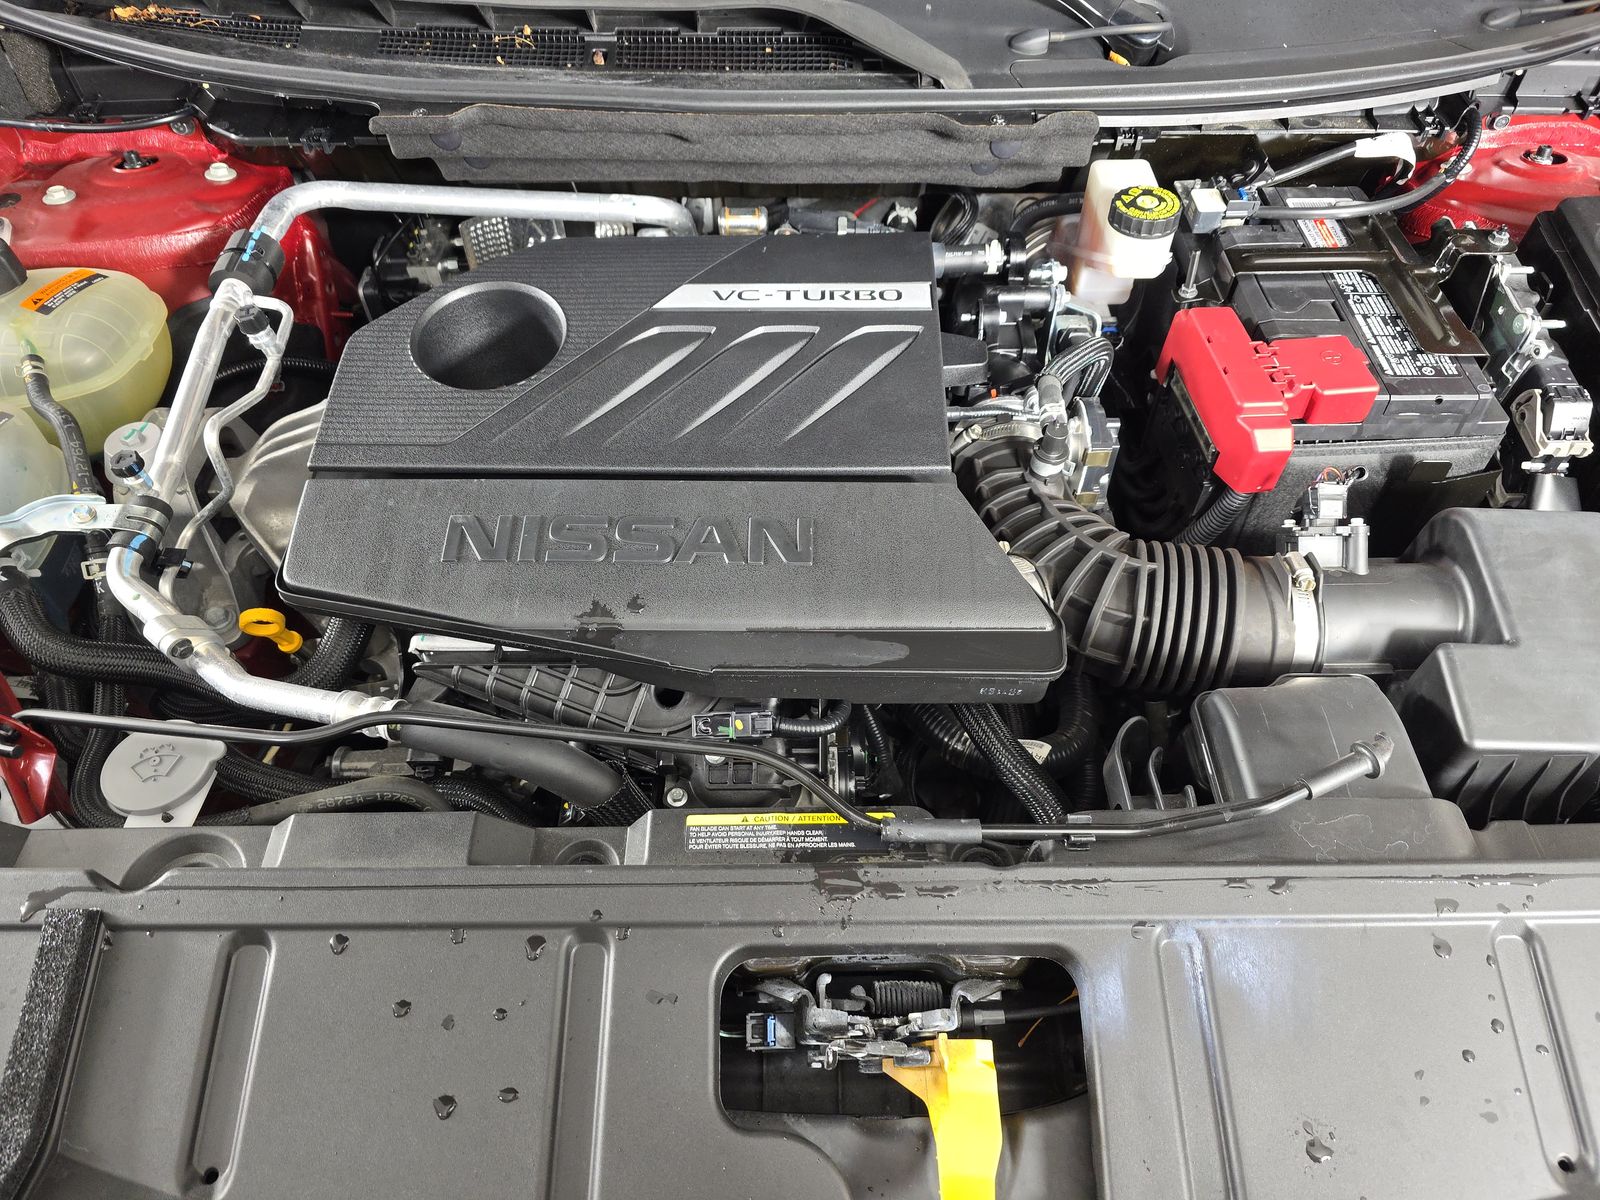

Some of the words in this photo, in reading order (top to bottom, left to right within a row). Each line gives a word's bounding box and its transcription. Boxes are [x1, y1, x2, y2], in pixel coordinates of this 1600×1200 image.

[712, 289, 903, 301] VC-TURBO
[441, 514, 815, 566] NISSAN
[753, 815, 789, 823] CAUTION
[797, 814, 841, 822] ATTENTION
